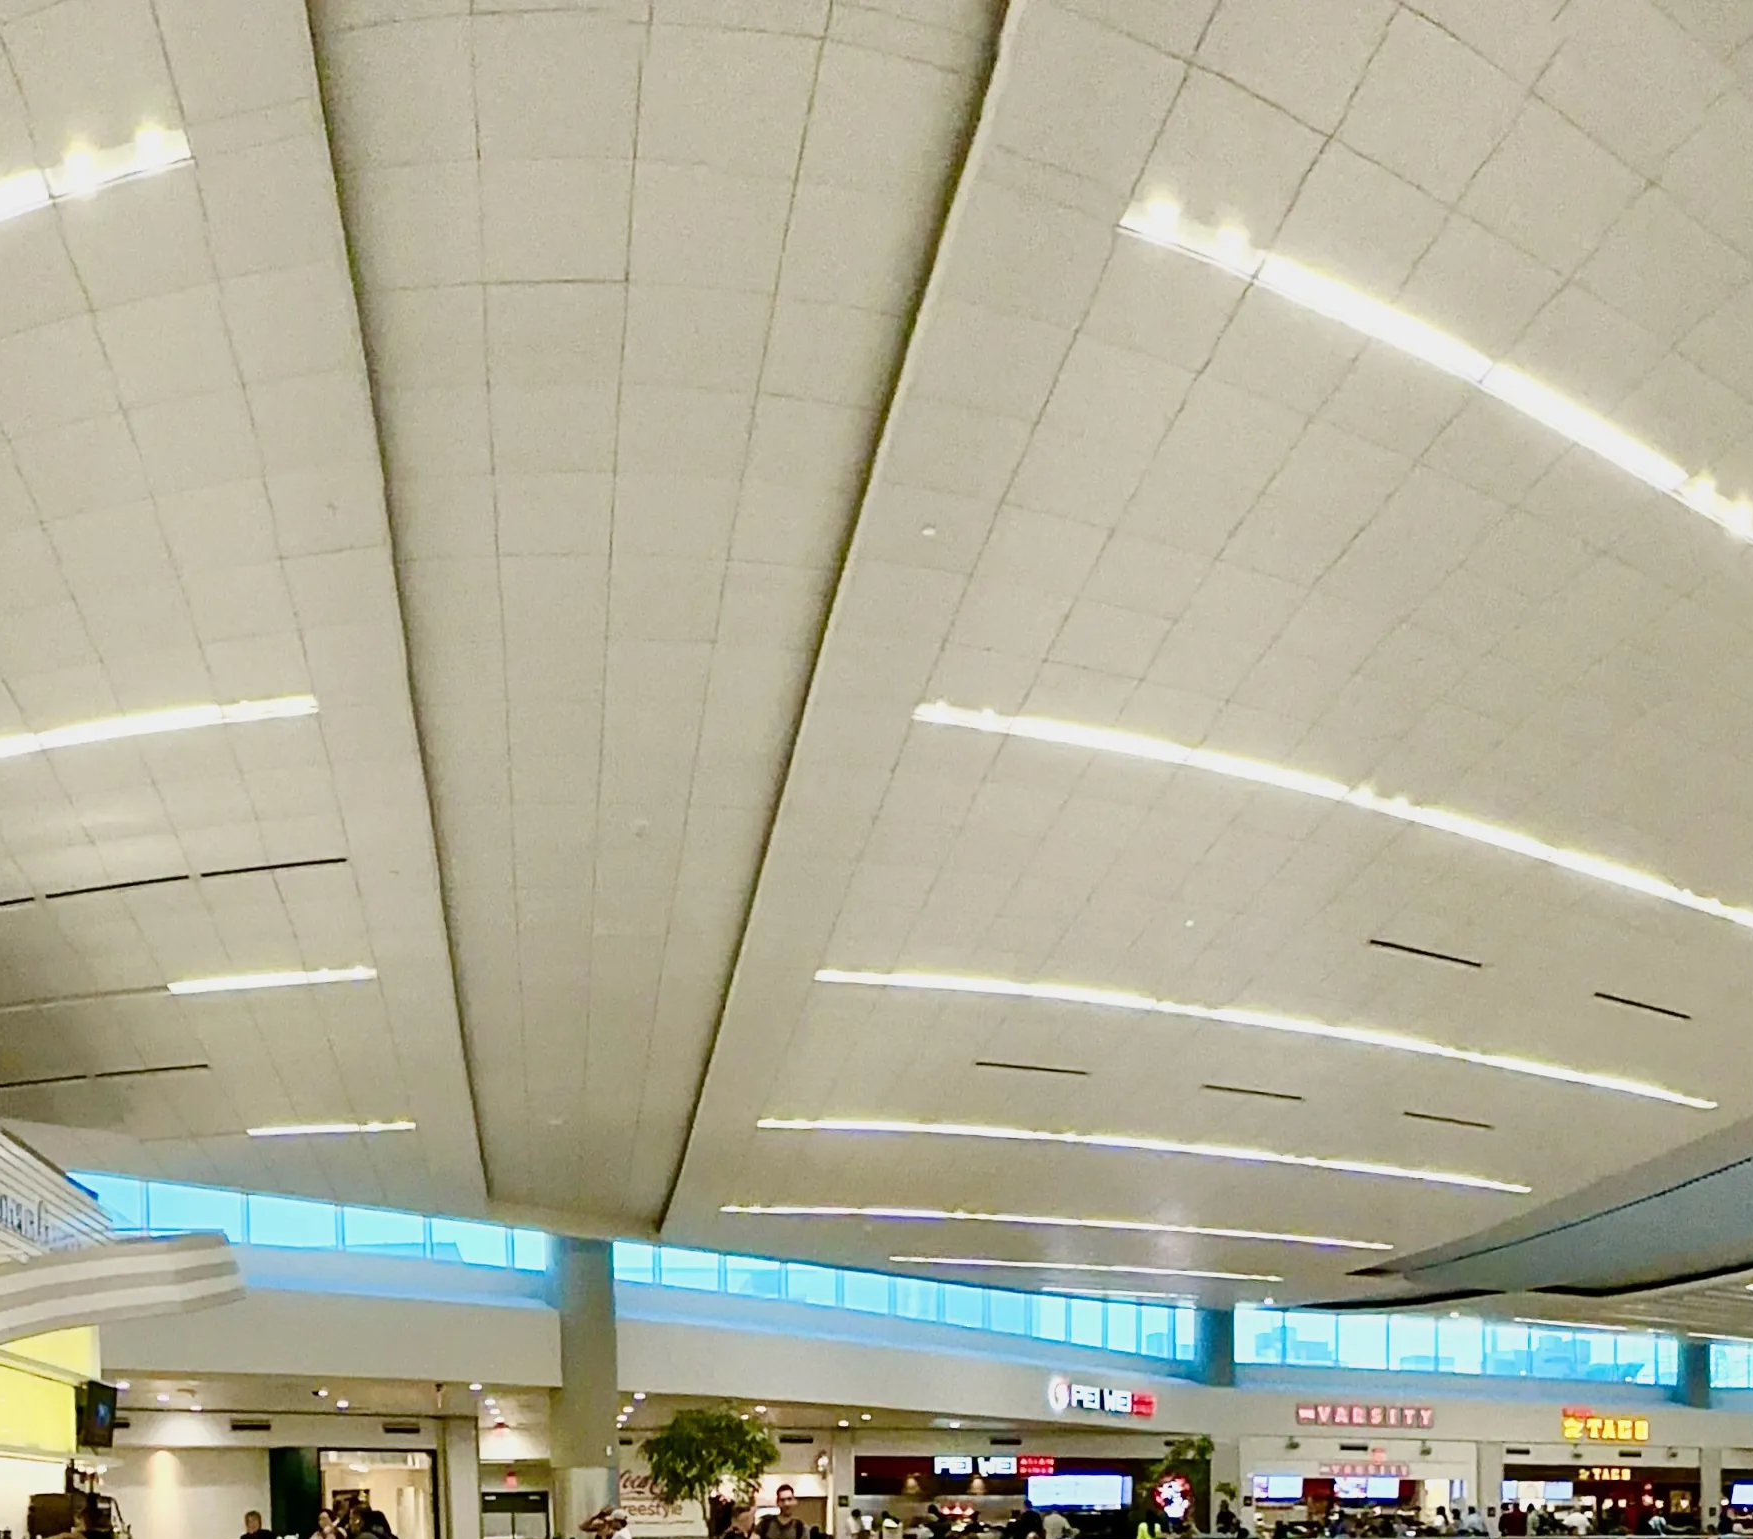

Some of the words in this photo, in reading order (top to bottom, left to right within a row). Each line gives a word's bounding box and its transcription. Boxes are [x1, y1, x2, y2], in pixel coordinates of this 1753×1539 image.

[1071, 1383, 1100, 1410] PEI
[1103, 1387, 1133, 1413] WEI
[1316, 1405, 1434, 1427] VARSITY
[1586, 1418, 1649, 1441] TACO
[934, 1456, 973, 1475] PEI
[977, 1456, 1018, 1477] WEI
[1592, 1468, 1631, 1481] TACO
